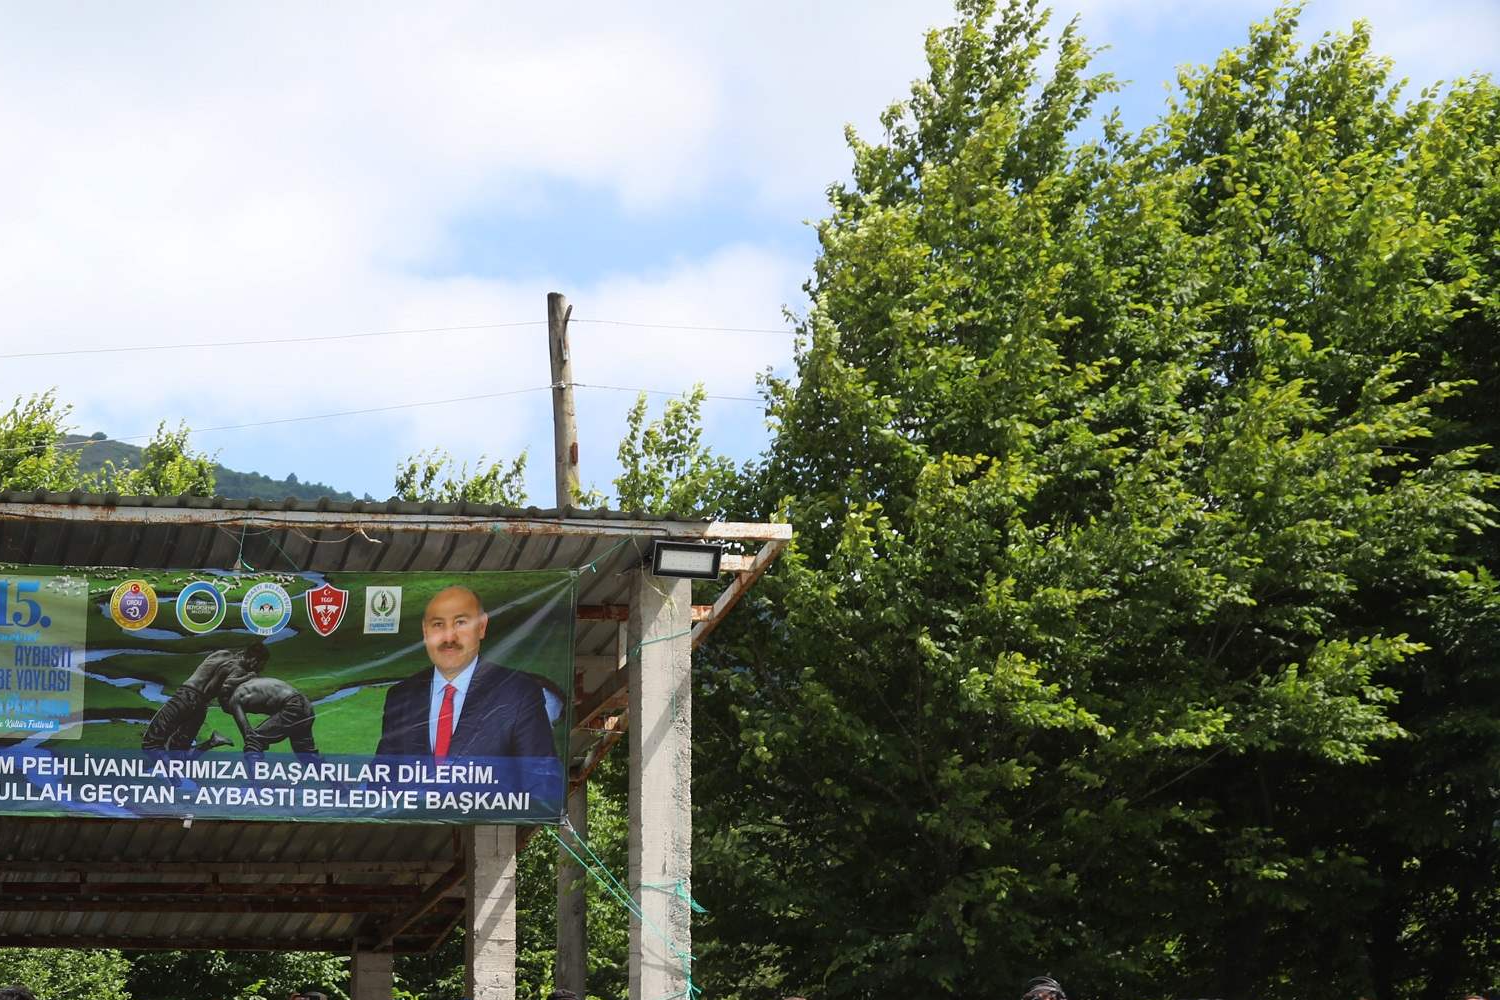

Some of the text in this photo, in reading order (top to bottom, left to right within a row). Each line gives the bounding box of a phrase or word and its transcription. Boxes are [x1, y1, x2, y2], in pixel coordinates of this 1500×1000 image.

[15, 645, 72, 668] AYBASTI
[17, 668, 71, 691] YAYLASI
[22, 754, 248, 780] PEHLİVANLARIMIZA
[254, 762, 391, 784] BAŞARILAR
[398, 761, 500, 785] DİLERİM.
[79, 784, 176, 807] GEÇTAN
[195, 787, 295, 807] AYBASTI
[302, 785, 418, 809] BELEDİYE
[425, 791, 530, 814] BAŞKANI
